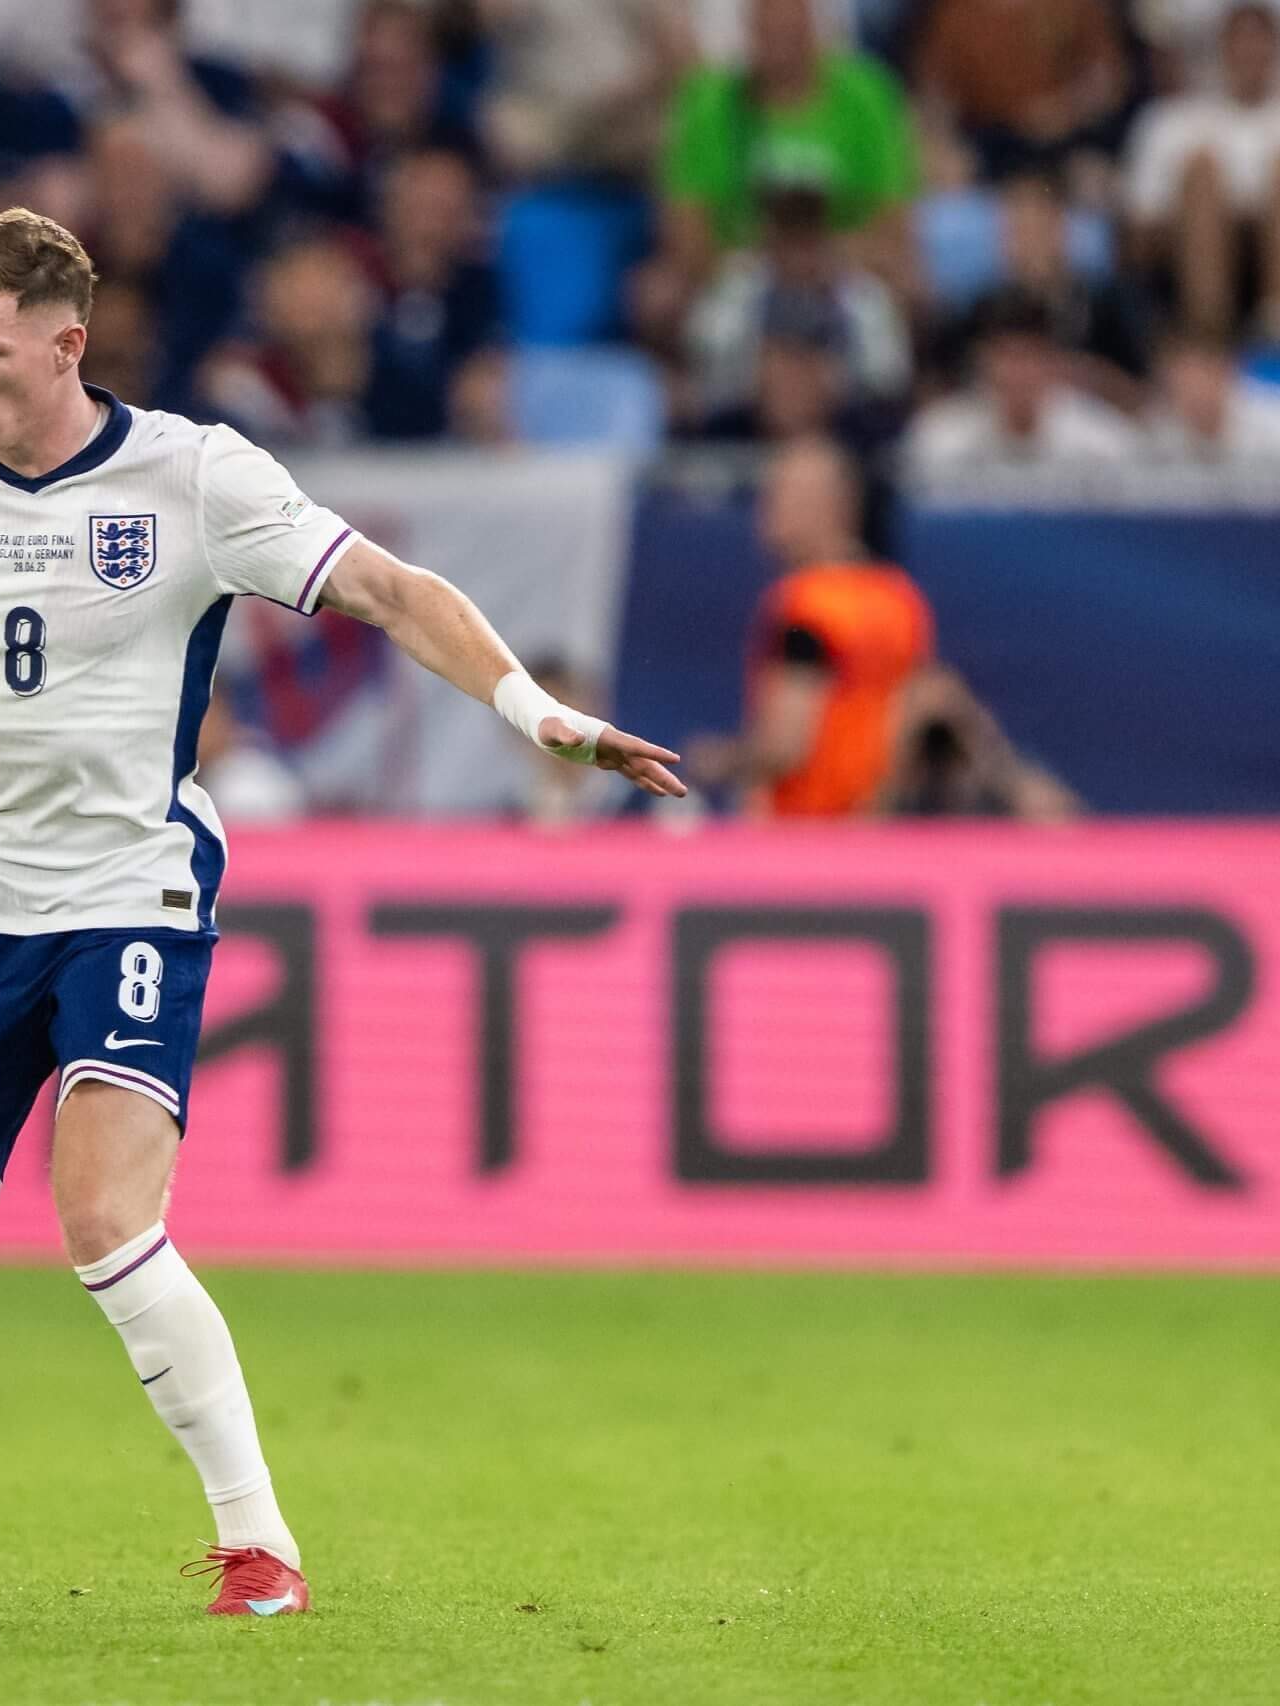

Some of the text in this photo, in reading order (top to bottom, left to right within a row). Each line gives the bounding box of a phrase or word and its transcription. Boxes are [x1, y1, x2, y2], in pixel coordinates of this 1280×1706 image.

[12, 535, 25, 546] U21
[27, 534, 48, 546] EURO
[52, 534, 75, 546] FINAL
[35, 548, 74, 560] GERMANY
[4, 605, 47, 697] 8
[118, 941, 164, 1023] 8
